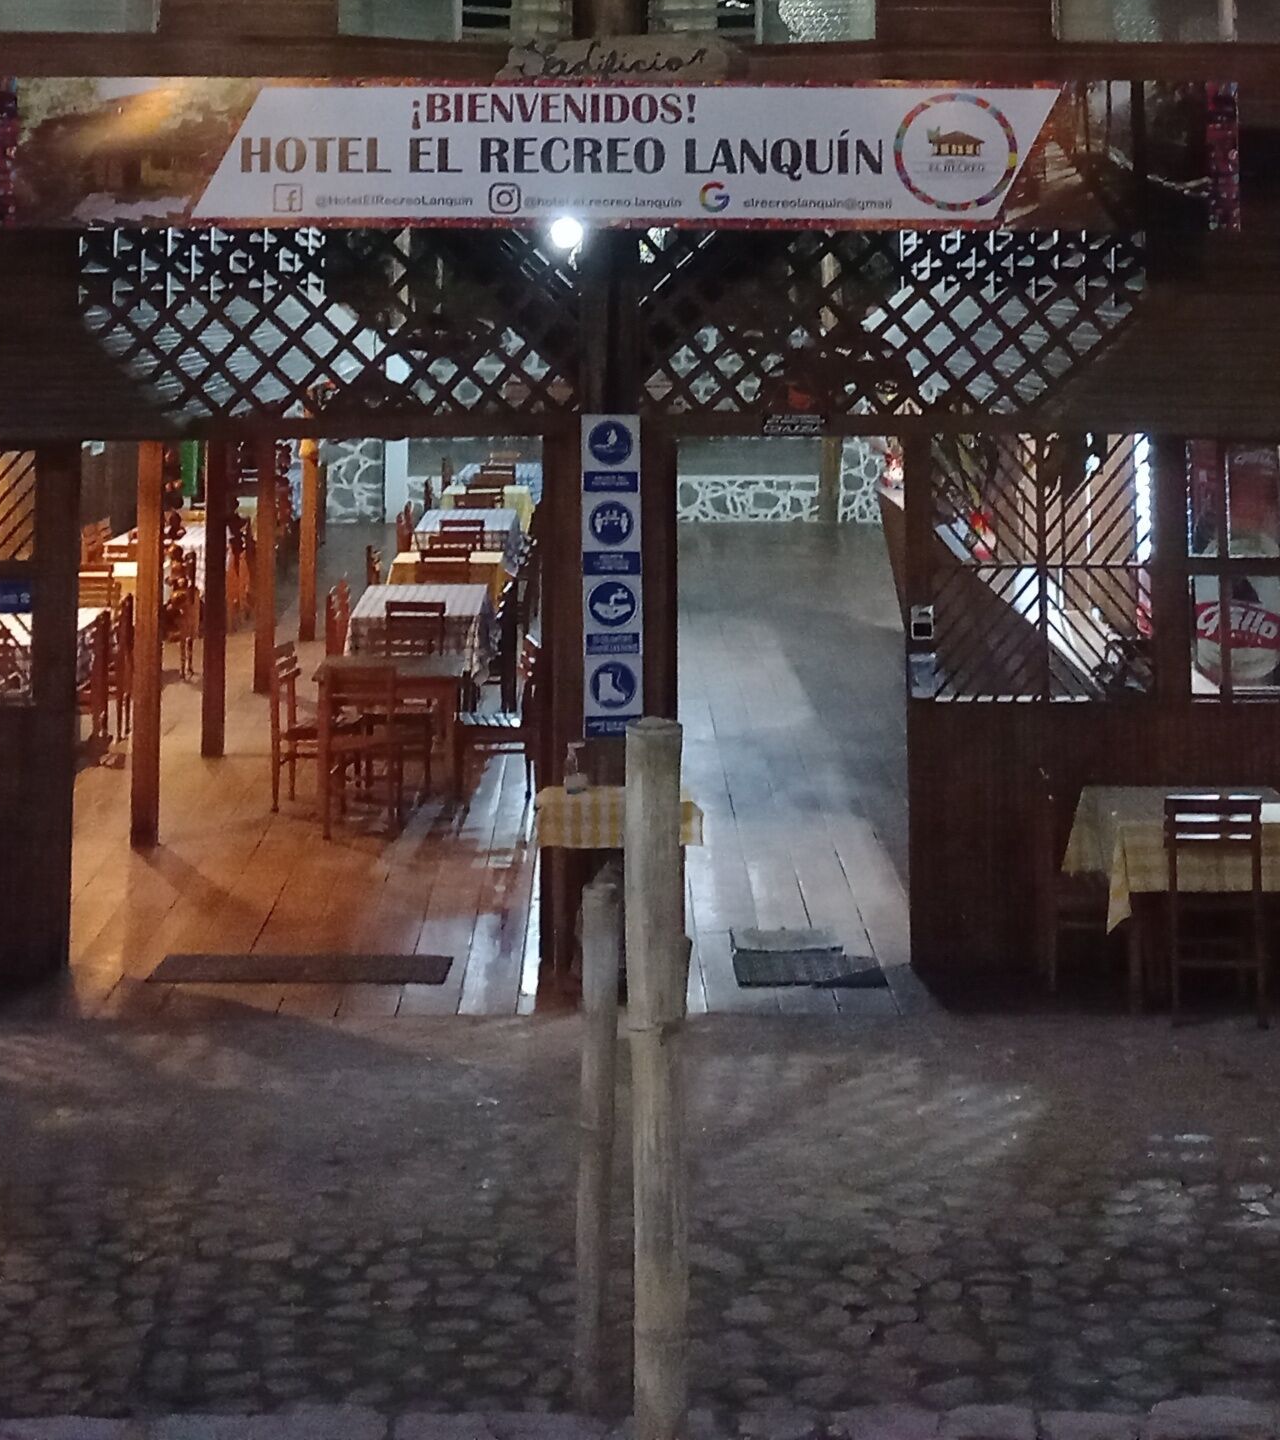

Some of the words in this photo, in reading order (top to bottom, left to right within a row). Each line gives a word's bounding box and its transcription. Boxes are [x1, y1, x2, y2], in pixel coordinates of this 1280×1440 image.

[412, 92, 696, 130] ¡BIENVENIDOS!
[240, 137, 392, 173] HOTEL
[409, 137, 463, 173] EL
[480, 137, 666, 175] RECREO
[685, 128, 883, 181] LANQUÍN
